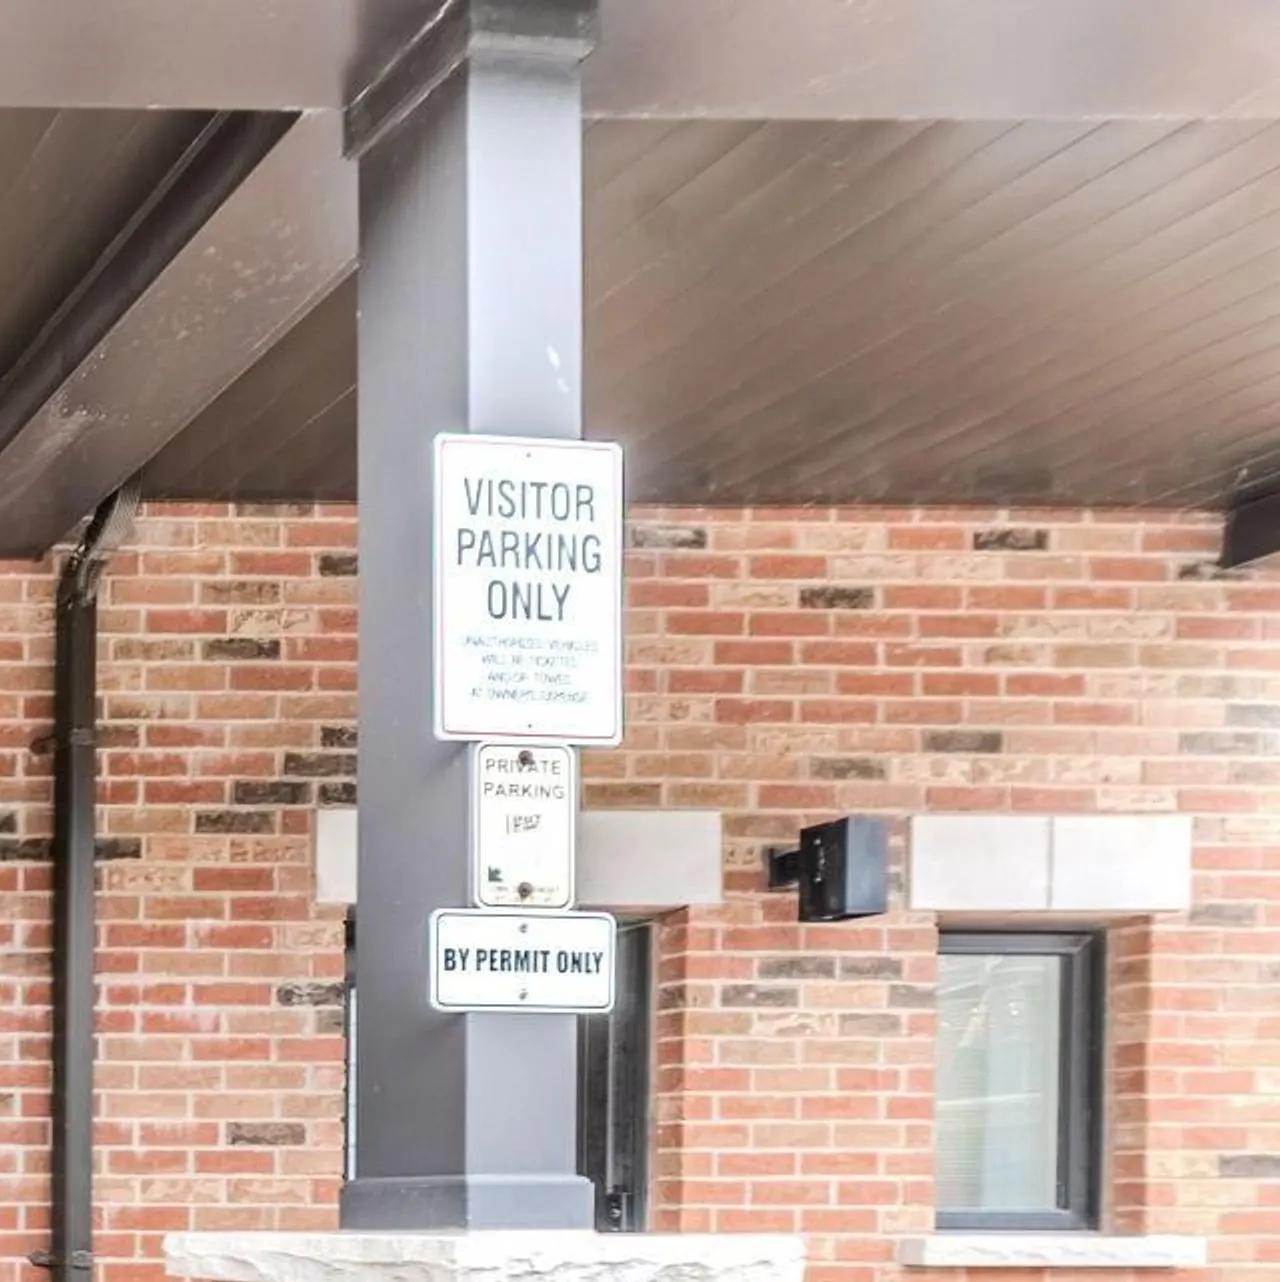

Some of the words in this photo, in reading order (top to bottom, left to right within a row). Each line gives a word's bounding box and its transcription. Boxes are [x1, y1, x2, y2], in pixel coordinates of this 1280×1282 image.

[463, 476, 595, 522] VISITOR
[457, 528, 602, 574] PARKING
[487, 580, 571, 621] ONLY
[485, 758, 562, 775] PRIVATE
[483, 781, 565, 799] PARKING
[443, 948, 470, 972] BY
[476, 948, 551, 973] PERMIT
[557, 951, 604, 974] ONLY
